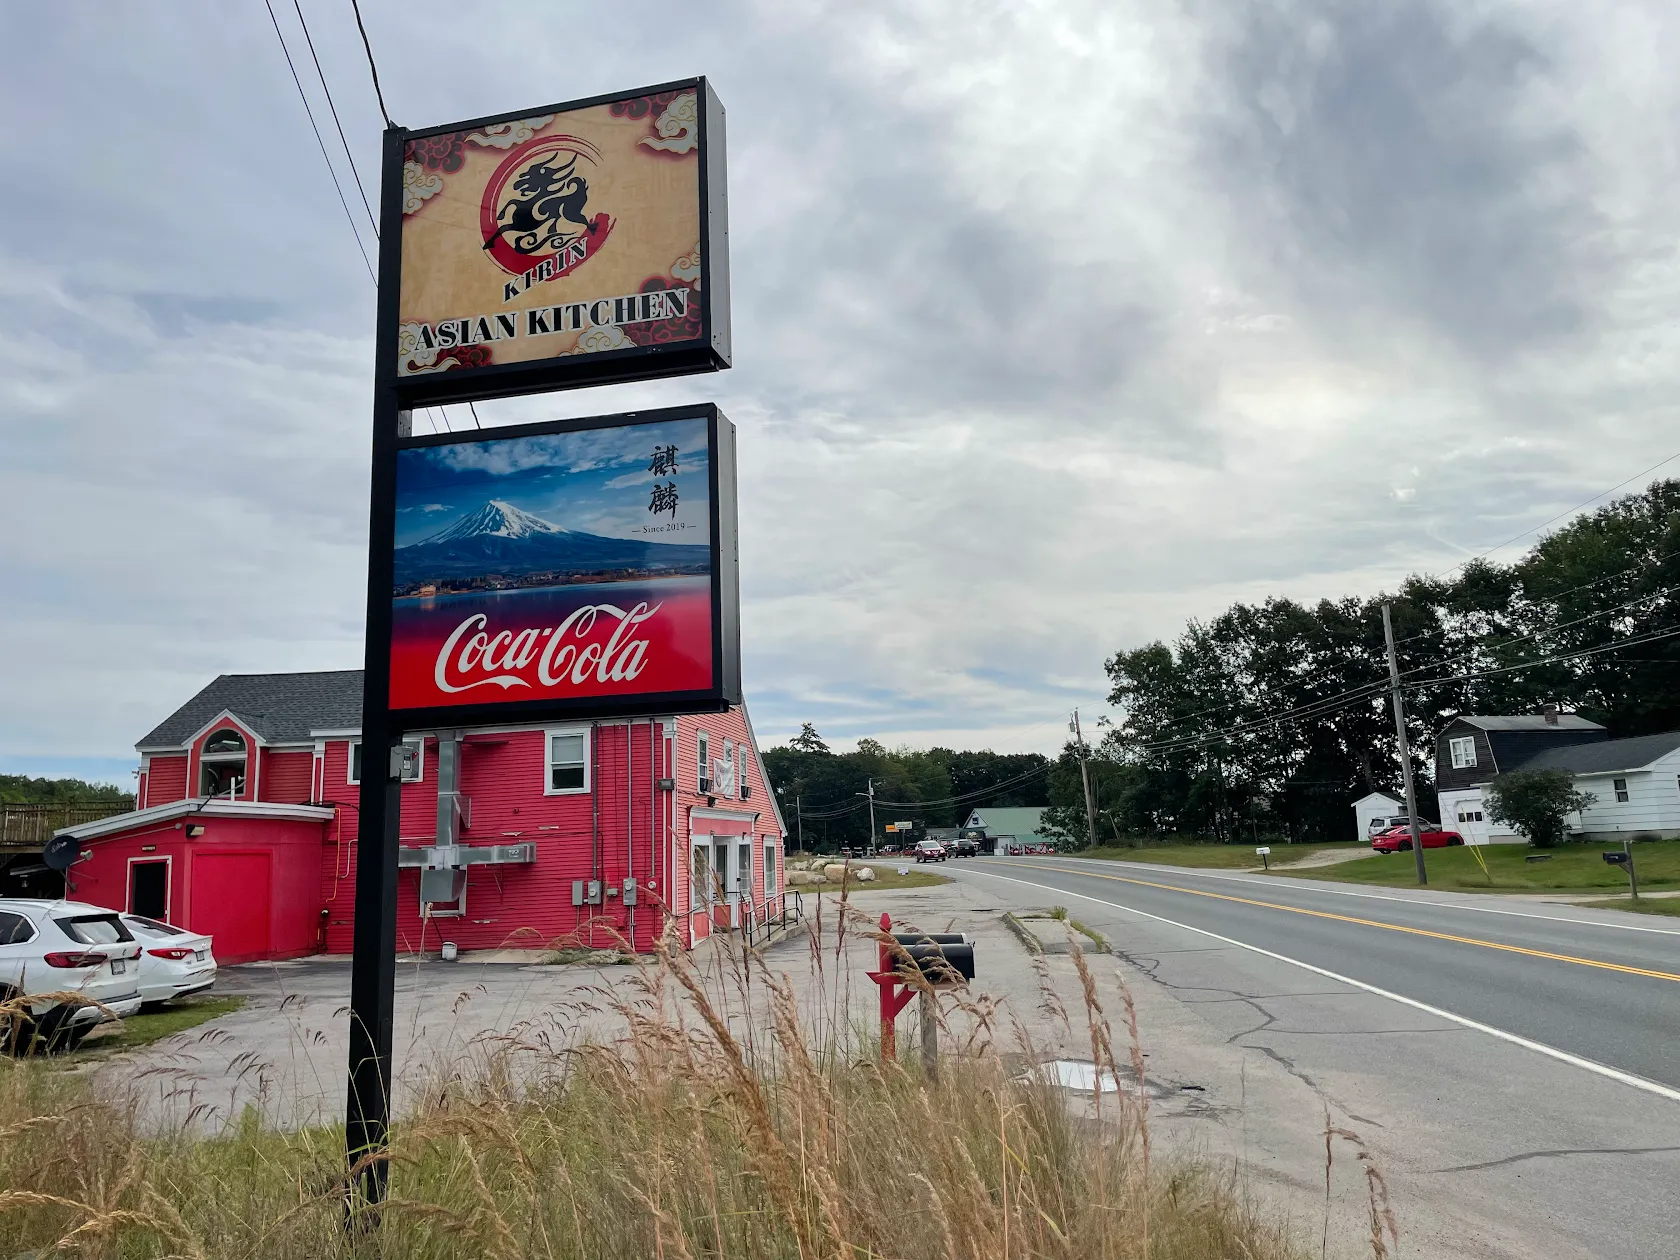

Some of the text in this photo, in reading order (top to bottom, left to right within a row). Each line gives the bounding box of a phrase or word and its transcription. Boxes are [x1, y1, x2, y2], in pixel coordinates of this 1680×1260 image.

[503, 237, 590, 303] KIRIN
[414, 288, 691, 352] ASIAN KITCHEN
[647, 444, 680, 521] 麒麟
[643, 522, 686, 534] Since 2019
[434, 600, 664, 693] Coca-Cola
